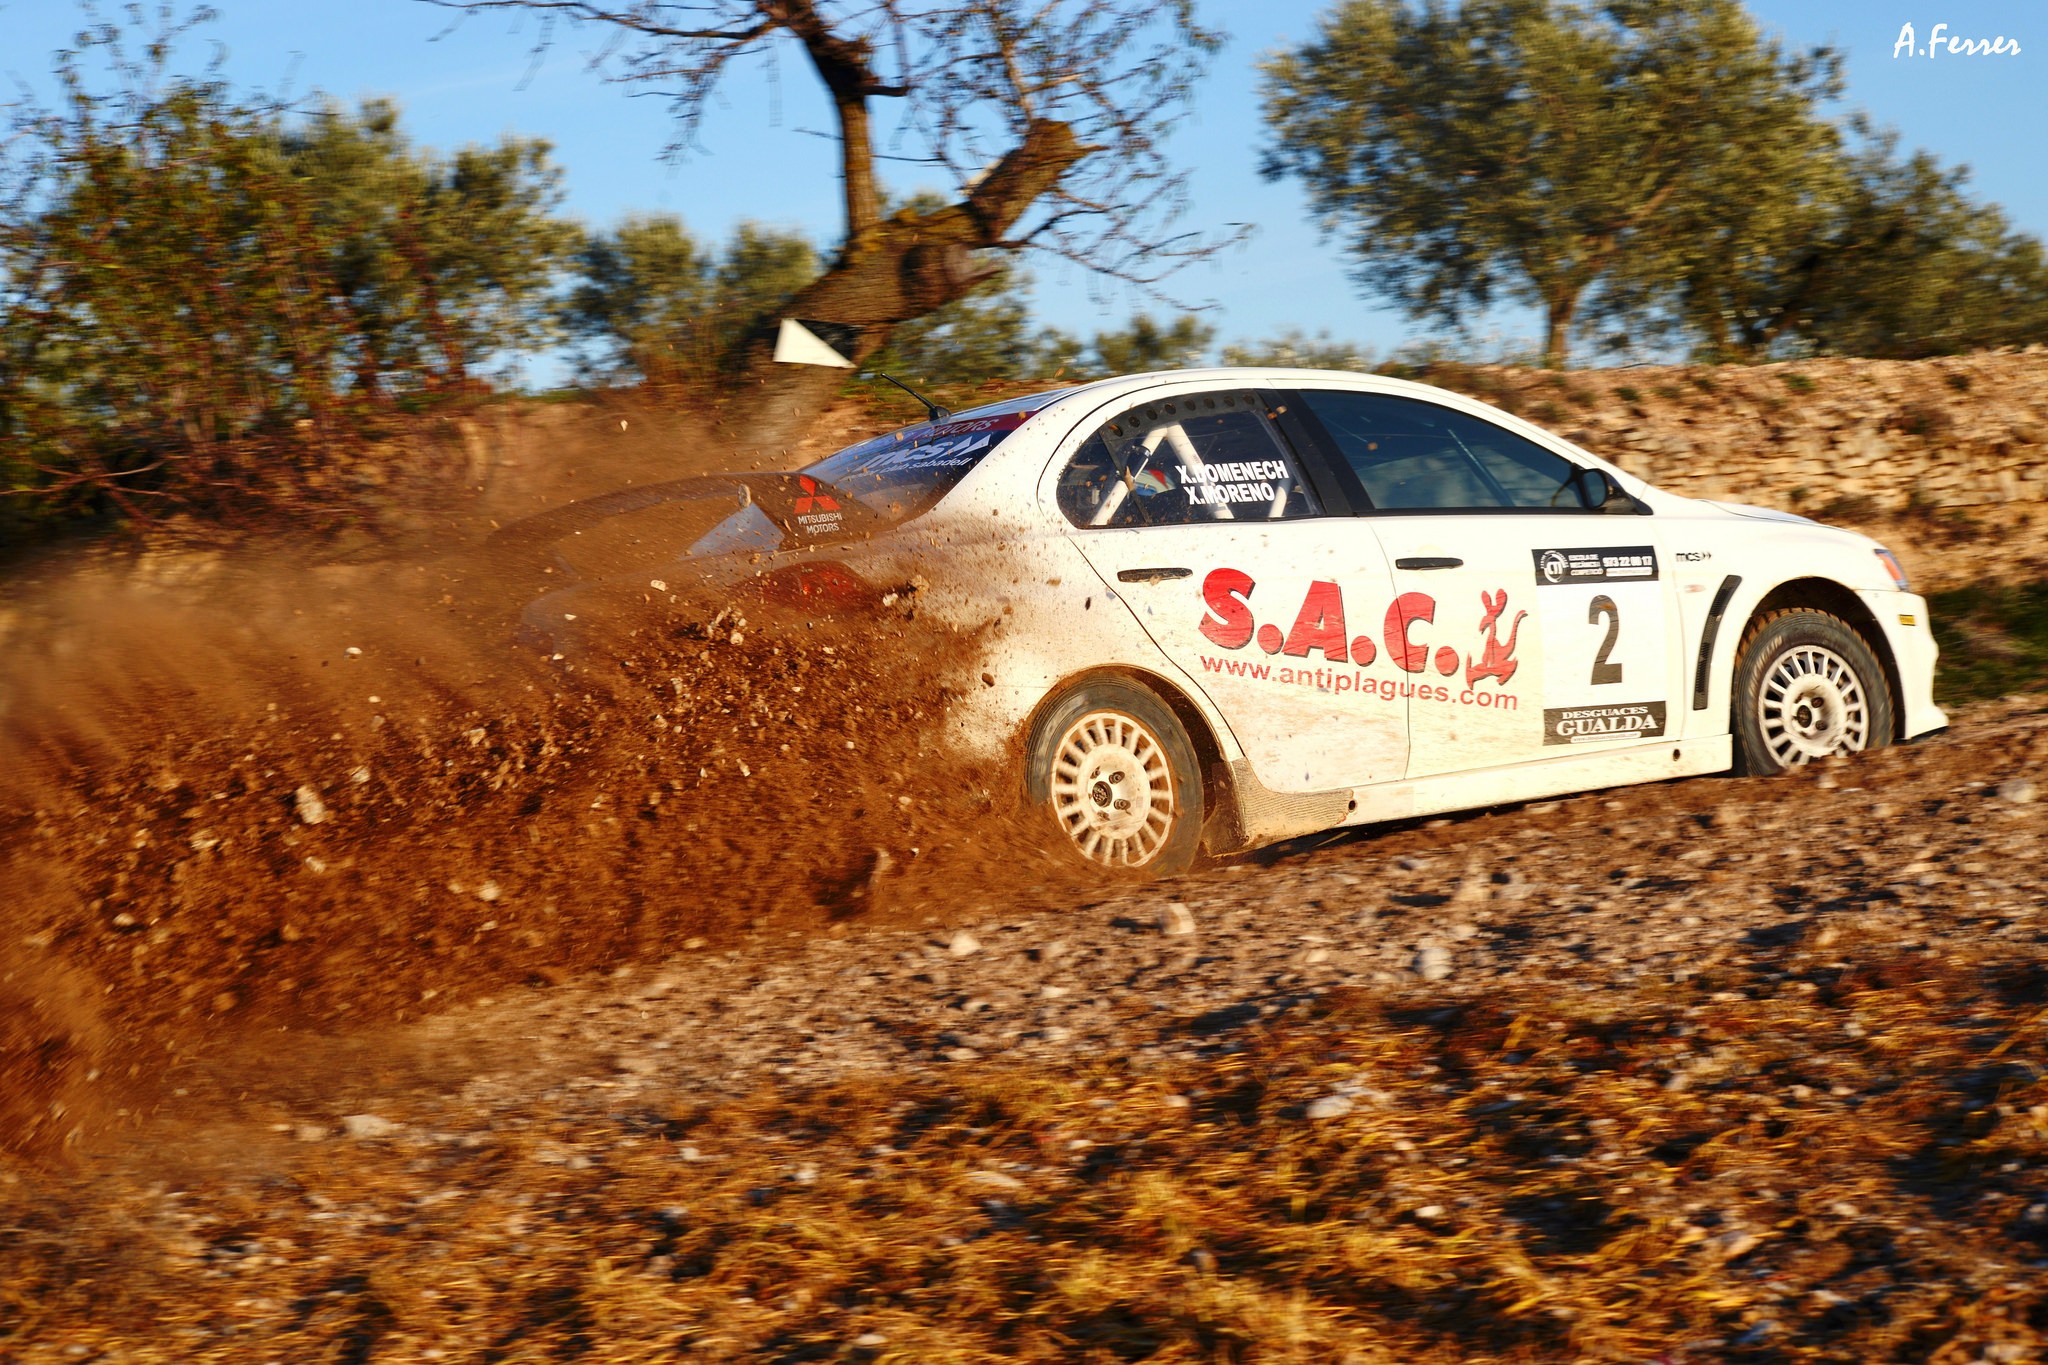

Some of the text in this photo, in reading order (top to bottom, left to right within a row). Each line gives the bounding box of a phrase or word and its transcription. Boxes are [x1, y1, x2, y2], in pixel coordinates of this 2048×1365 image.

[797, 512, 843, 525] MITSUBISHI
[806, 522, 840, 534] MOTORS
[1198, 567, 1460, 677] S.A.C.
[1588, 594, 1623, 686] 2
[1199, 655, 1519, 711] www.antiplagues.com
[1562, 706, 1649, 719] DESGUACES
[1556, 714, 1659, 736] GUALDA
